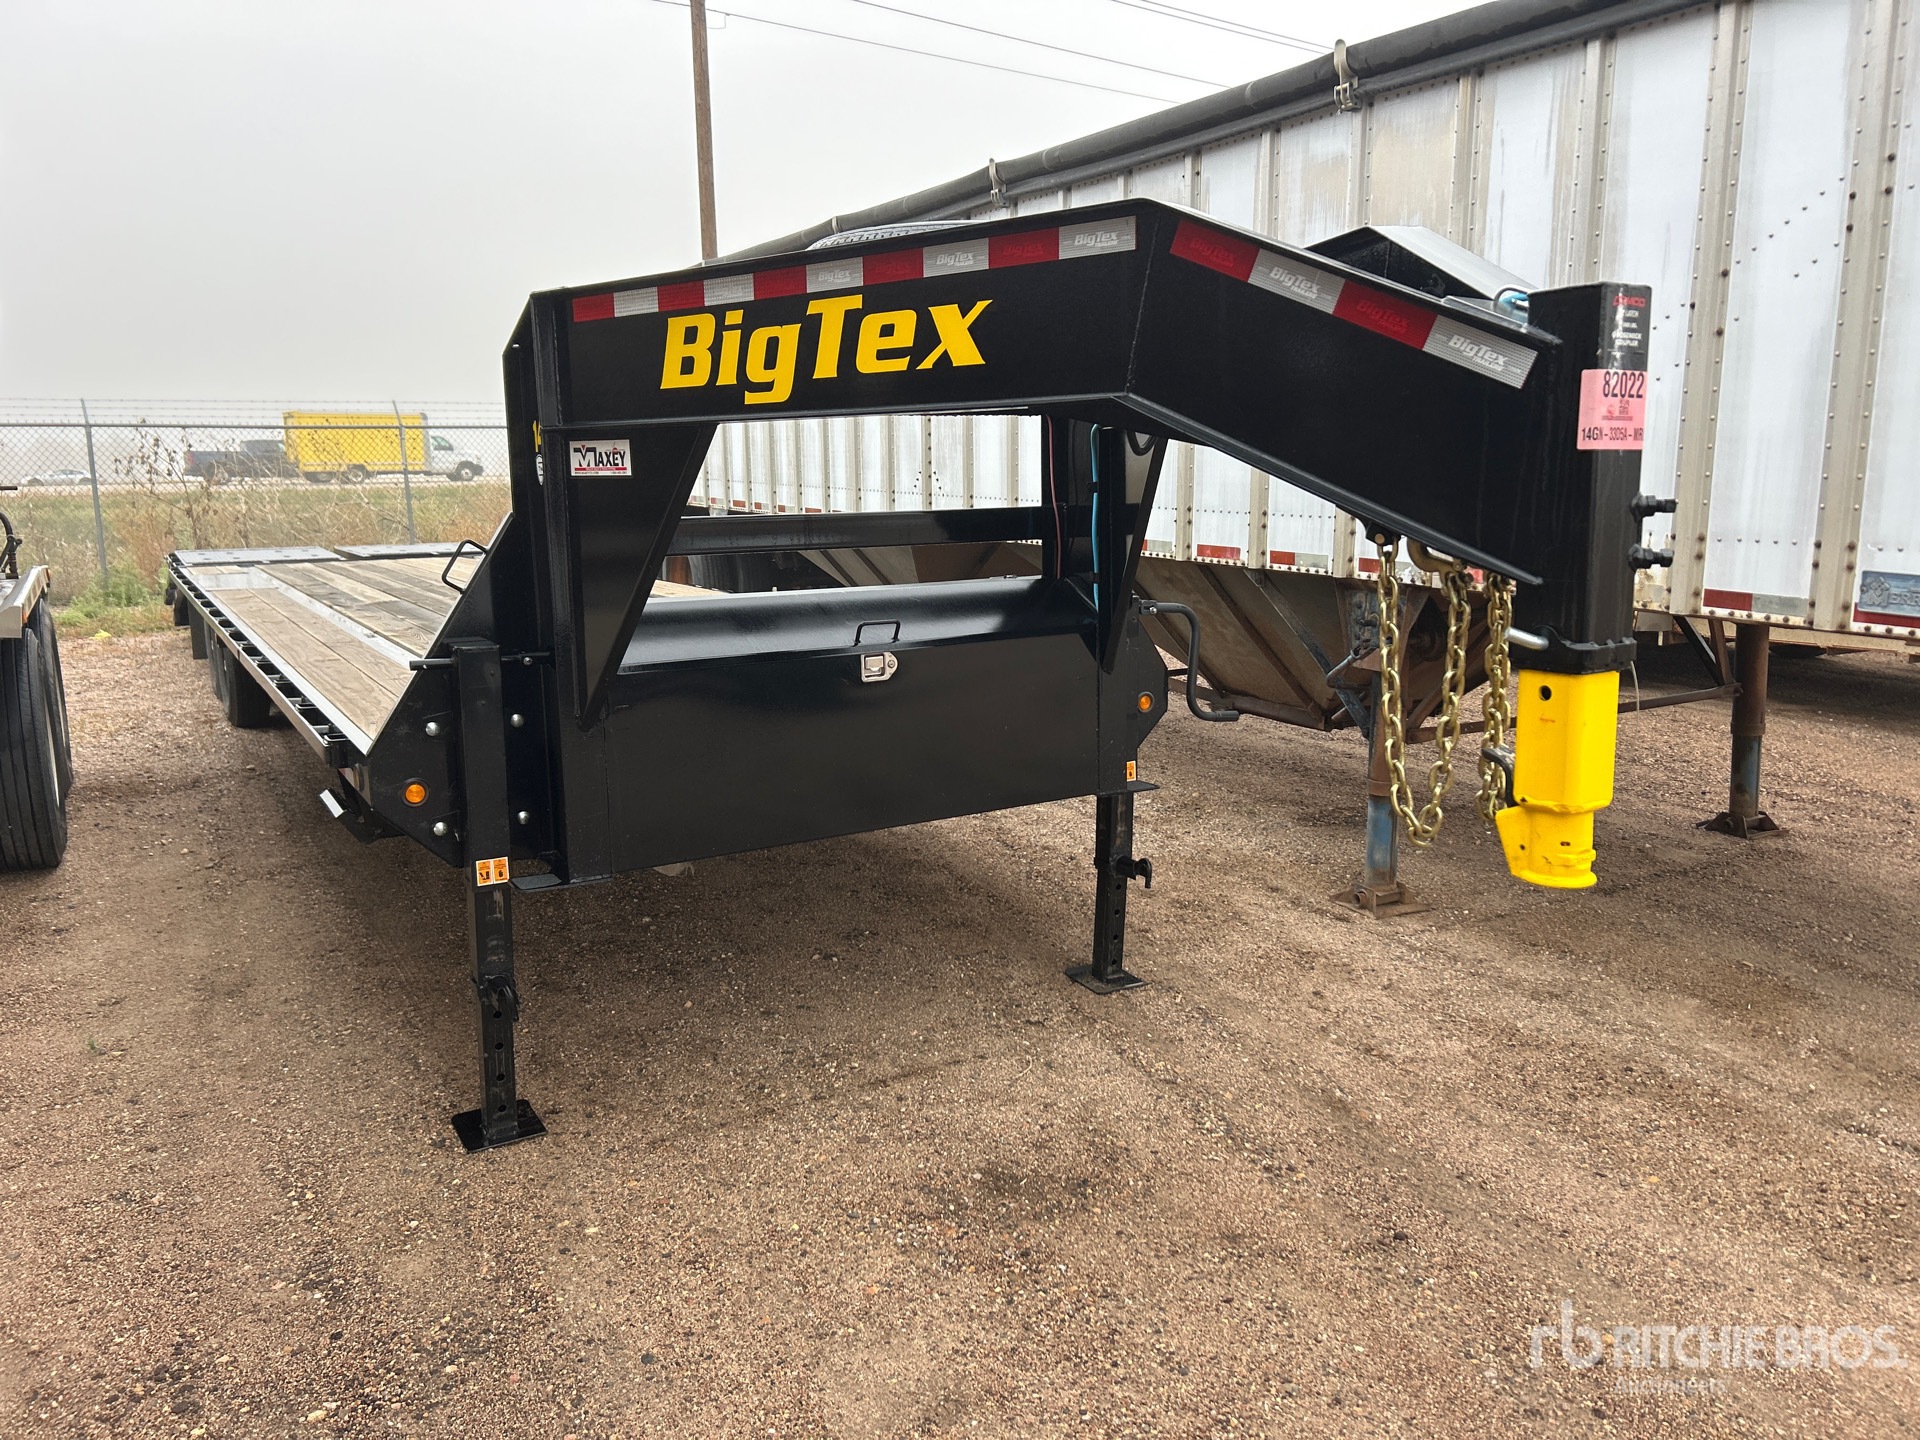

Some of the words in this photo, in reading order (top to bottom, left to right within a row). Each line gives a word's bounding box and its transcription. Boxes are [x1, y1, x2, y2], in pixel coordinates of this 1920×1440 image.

[1074, 230, 1119, 247] BigTex
[936, 251, 975, 266] BigTex
[1269, 266, 1321, 293] BigTex
[660, 294, 993, 405] BigTex
[1448, 334, 1509, 365] BigTex
[1602, 371, 1645, 399] 82022
[573, 445, 626, 468] MAXEY
